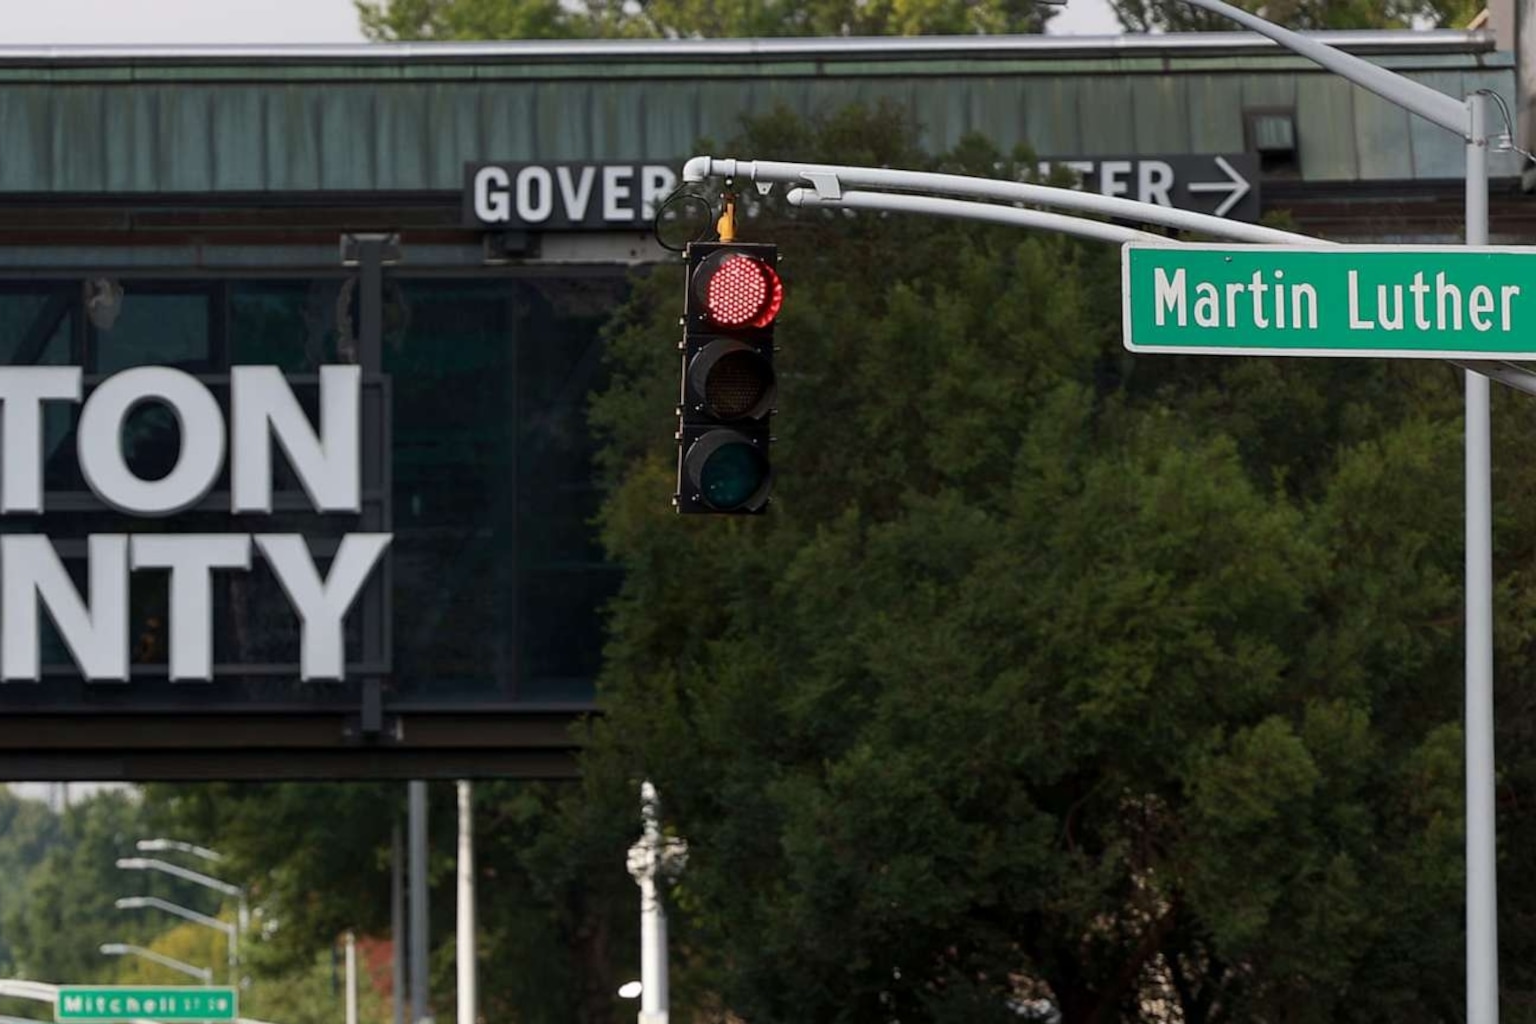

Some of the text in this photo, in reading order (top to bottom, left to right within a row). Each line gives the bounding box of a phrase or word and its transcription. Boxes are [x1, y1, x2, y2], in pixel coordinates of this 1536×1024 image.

[1154, 267, 1520, 332] Martin Luther
[64, 995, 175, 1014] Mitchell
